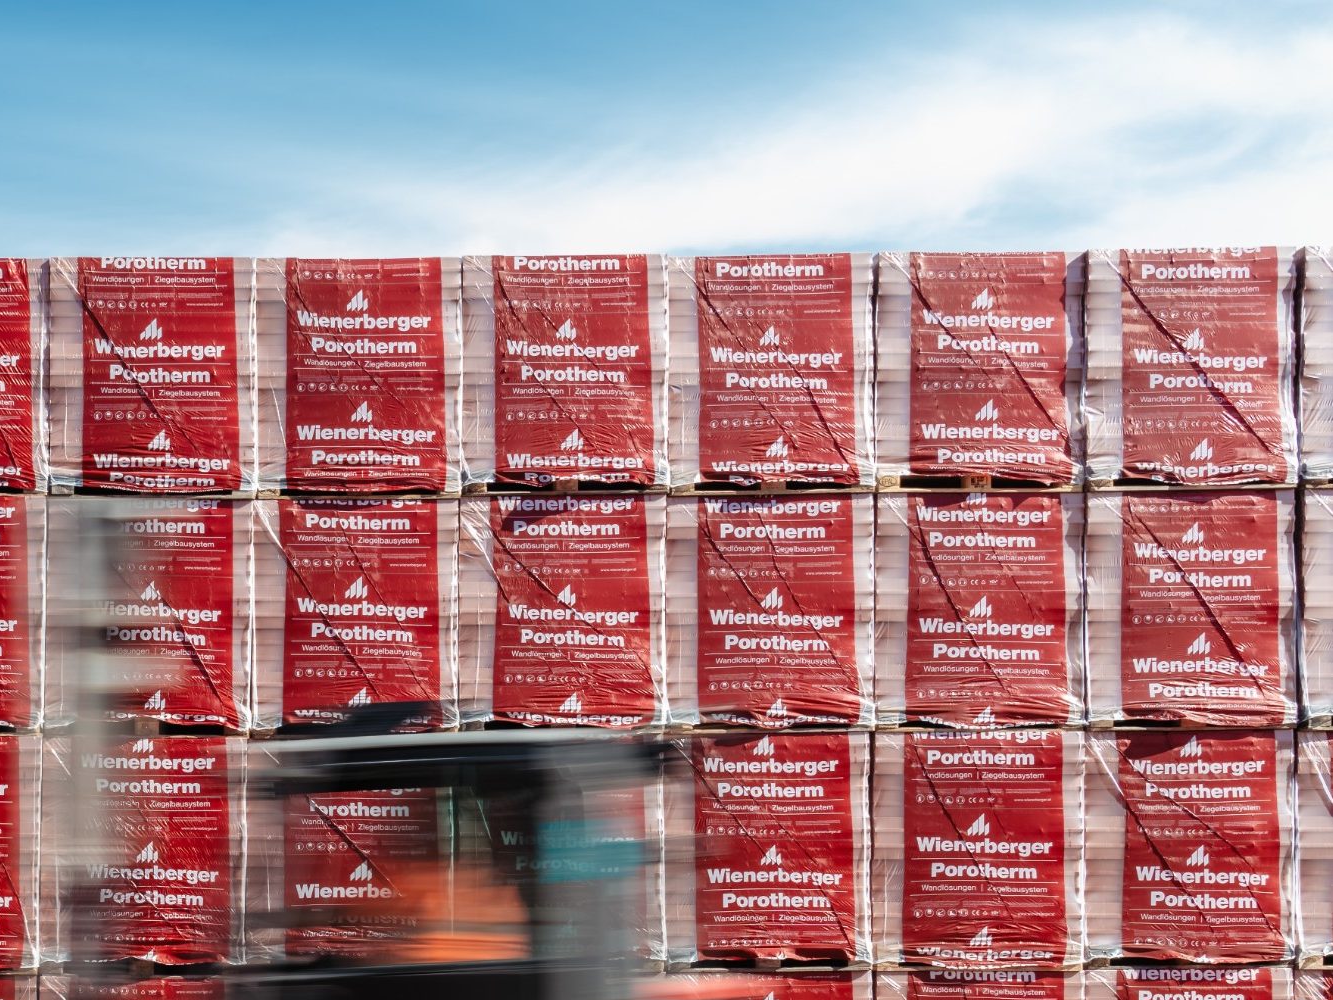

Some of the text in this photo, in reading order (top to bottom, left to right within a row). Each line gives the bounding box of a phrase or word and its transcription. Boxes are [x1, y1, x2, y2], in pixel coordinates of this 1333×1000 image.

[101, 257, 206, 270] Porotherm
[513, 256, 620, 271] Porotherm
[716, 263, 824, 277] Porotherm
[1142, 265, 1249, 278] Porotherm
[92, 275, 216, 285] Wandlösungen Ziegelbausystem
[772, 283, 834, 292] Ziegelbausystem
[298, 311, 431, 331] Wienerberger
[365, 360, 427, 370] Ziegelbausystem
[522, 366, 624, 382] Porotherm
[297, 425, 435, 444] Wienerberger
[922, 424, 1059, 442] Wienerberger
[94, 453, 230, 468] Wienerberger
[312, 451, 420, 465] Porotherm
[507, 453, 643, 468] Wienerberger
[938, 449, 1045, 464] Porotherm
[712, 460, 849, 473] Wienerberger
[499, 497, 634, 513] Wienerberger
[706, 500, 840, 516] Wienerberger
[306, 514, 410, 530] Porotherm
[917, 506, 1051, 525] Wienerberger
[514, 521, 619, 535] Porotherm
[720, 524, 825, 538] Porotherm
[153, 539, 215, 548] Ziegelbausystem
[358, 536, 420, 546] Ziegelbausystem
[506, 541, 630, 550] Wandlösungen Ziegelbausystem
[930, 532, 1035, 547] Porotherm
[710, 610, 843, 629] Wienerberger
[521, 629, 624, 646] Porotherm
[934, 644, 1039, 660] Porotherm
[923, 664, 979, 673] Wandlösungen
[1149, 684, 1259, 698] Porotherm
[81, 755, 216, 773] Wienerberger
[928, 750, 1034, 765] Porotherm
[704, 758, 838, 775] Wienerberger
[1130, 760, 1265, 776] Wienerberger
[982, 772, 1045, 780] Ziegelbausystem
[95, 779, 201, 794] Porotherm
[718, 783, 823, 797] Porotherm
[772, 804, 834, 812] Ziegelbausystem
[708, 868, 842, 885] Wienerberger
[931, 863, 1037, 879] Porotherm
[921, 884, 977, 892] Wandlösungen
[100, 889, 205, 906] Porotherm
[723, 893, 830, 907] Porotherm
[1140, 914, 1196, 922] Wandlösungen
[930, 970, 1035, 983] Porotherm
[983, 988, 1046, 997] Ziegelbausystem
